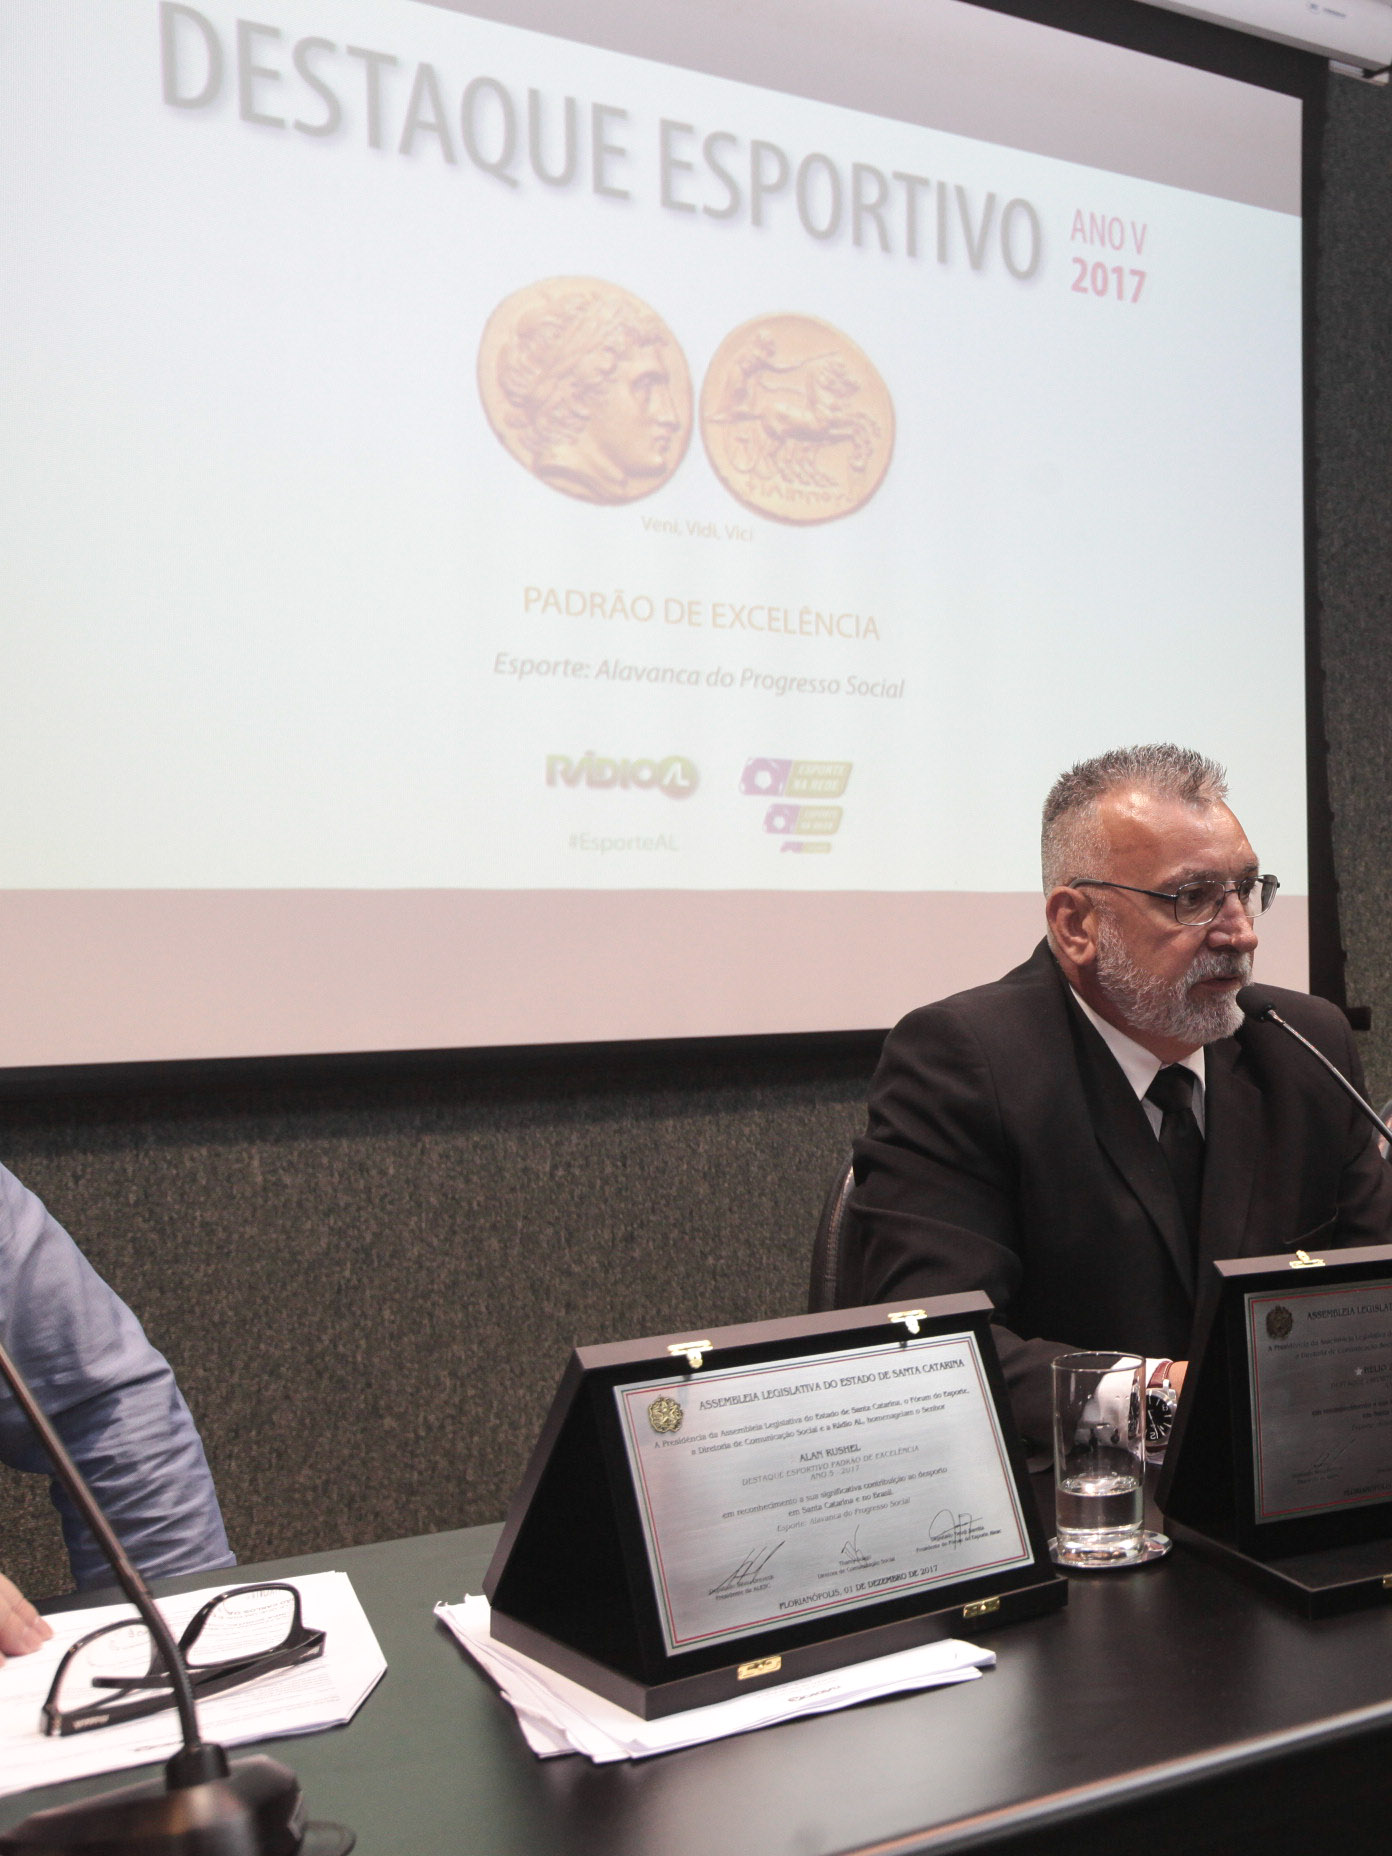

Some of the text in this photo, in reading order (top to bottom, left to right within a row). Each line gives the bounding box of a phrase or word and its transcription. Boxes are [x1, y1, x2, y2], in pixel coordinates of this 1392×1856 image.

[158, 1, 1042, 283] DESTAQUE ESPORTIVO
[1069, 208, 1148, 256] ANO V
[1069, 257, 1148, 304] 2017
[523, 585, 881, 641] PADRÃO DE EXCELÊNCIA
[493, 651, 906, 700] Esporte: Alavanca do Progresso Social
[568, 832, 680, 854] #EsporteAL
[1308, 1307, 1355, 1320] ASSEMBLEIA
[699, 1359, 965, 1410] ASSEMBLEIA LEGISLATIVA DO ESTADO DE SANTA CATARINA
[766, 1417, 803, 1430] Legislativa
[816, 1411, 839, 1419] Estado
[852, 1405, 871, 1413] Santa
[798, 1426, 818, 1435] Social
[800, 1443, 862, 1462] ALAN RUSHEL
[742, 1471, 784, 1486] DESTAQUE
[787, 1462, 829, 1477] ESPORTIVO
[856, 1583, 866, 1591] DE
[909, 1569, 920, 1578] DE
[921, 1564, 939, 1574] 2017
